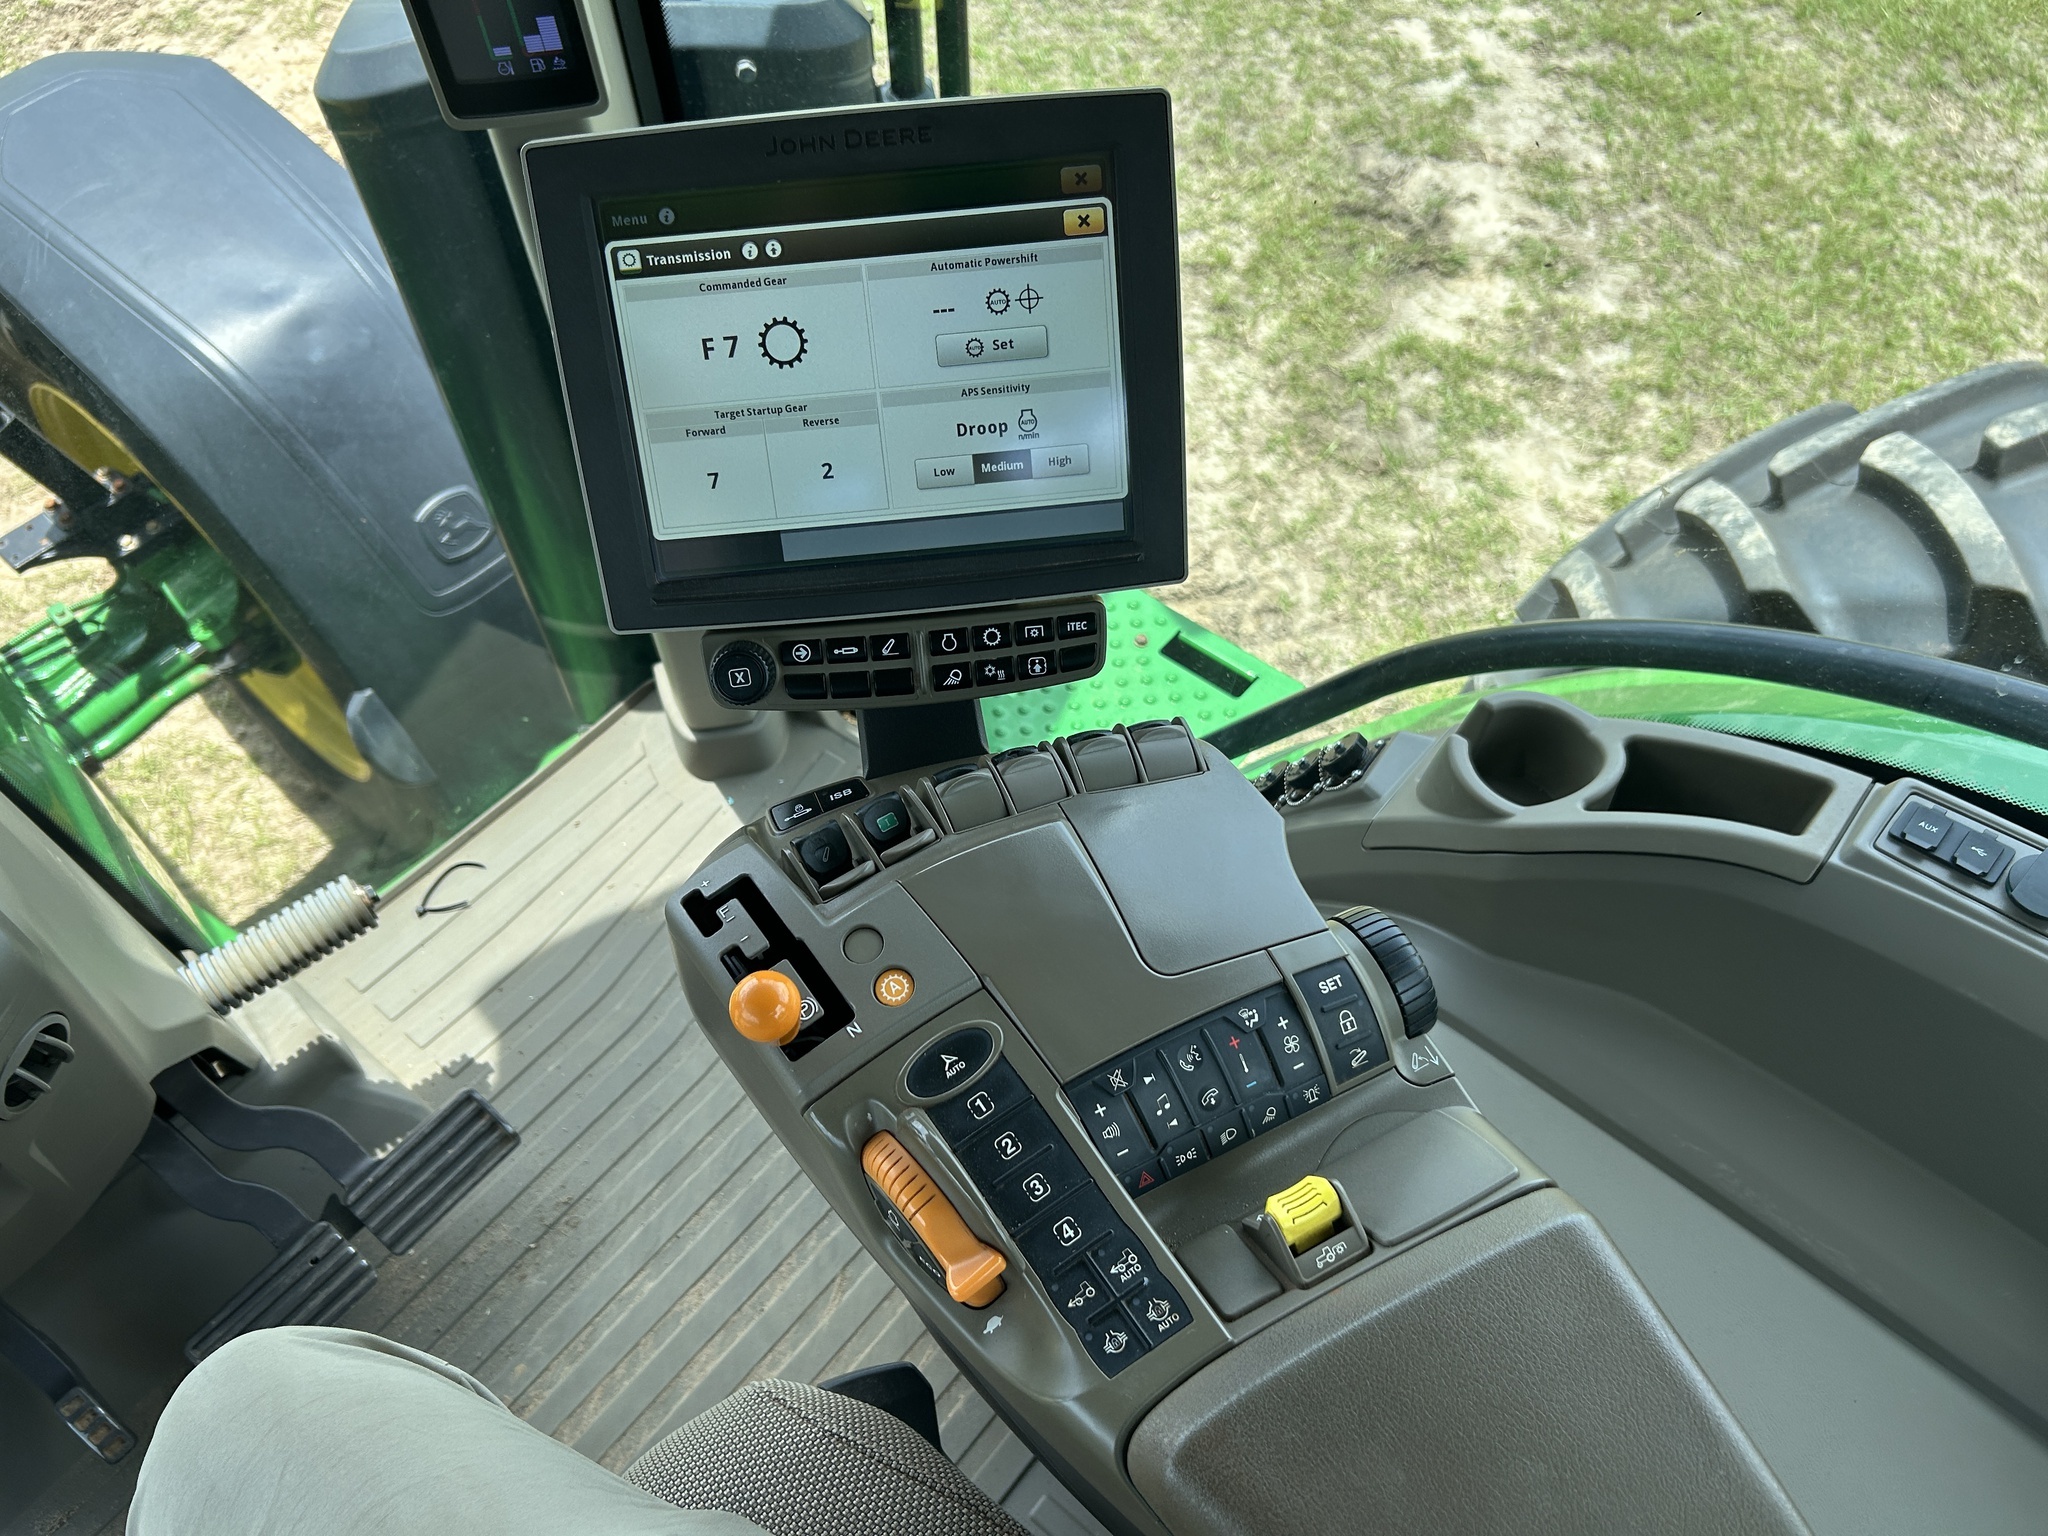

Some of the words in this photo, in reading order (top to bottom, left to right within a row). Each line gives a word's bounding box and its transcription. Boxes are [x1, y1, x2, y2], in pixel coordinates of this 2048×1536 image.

[765, 133, 836, 158] JOHN
[843, 125, 933, 151] DEERE
[612, 214, 648, 227] Menu
[646, 249, 732, 267] Transmission
[930, 261, 983, 272] Automatic
[985, 253, 1038, 267] Powershift
[699, 278, 762, 292] Commanded
[763, 277, 787, 287] Gear
[702, 338, 715, 360] F
[722, 335, 738, 358] 7
[992, 338, 1015, 351] Set
[961, 388, 979, 397] APS
[981, 383, 1031, 395] Sensitivity
[714, 410, 745, 421] Target
[746, 407, 783, 418] Startup
[785, 403, 808, 414] Gear
[685, 425, 726, 438] Forward
[802, 416, 840, 428] Reverse
[956, 421, 1009, 438] Droop
[1018, 432, 1040, 441] n/min
[933, 467, 955, 478] Low
[981, 460, 1024, 473] Medium
[1048, 455, 1072, 468] High
[707, 472, 719, 490] 7
[821, 462, 835, 480] 2
[1066, 620, 1088, 632] iTEC
[829, 788, 853, 801] ISB
[1918, 820, 1939, 834] AUX
[1318, 974, 1343, 994] SET
[846, 1022, 863, 1038] N
[945, 1061, 966, 1079] AUTO
[974, 1098, 987, 1113] 1
[1001, 1138, 1017, 1155] 2
[1030, 1180, 1044, 1195] 3
[1062, 1222, 1075, 1239] 4
[1120, 1263, 1142, 1283] AUTO
[1157, 1313, 1180, 1333] AUTO
